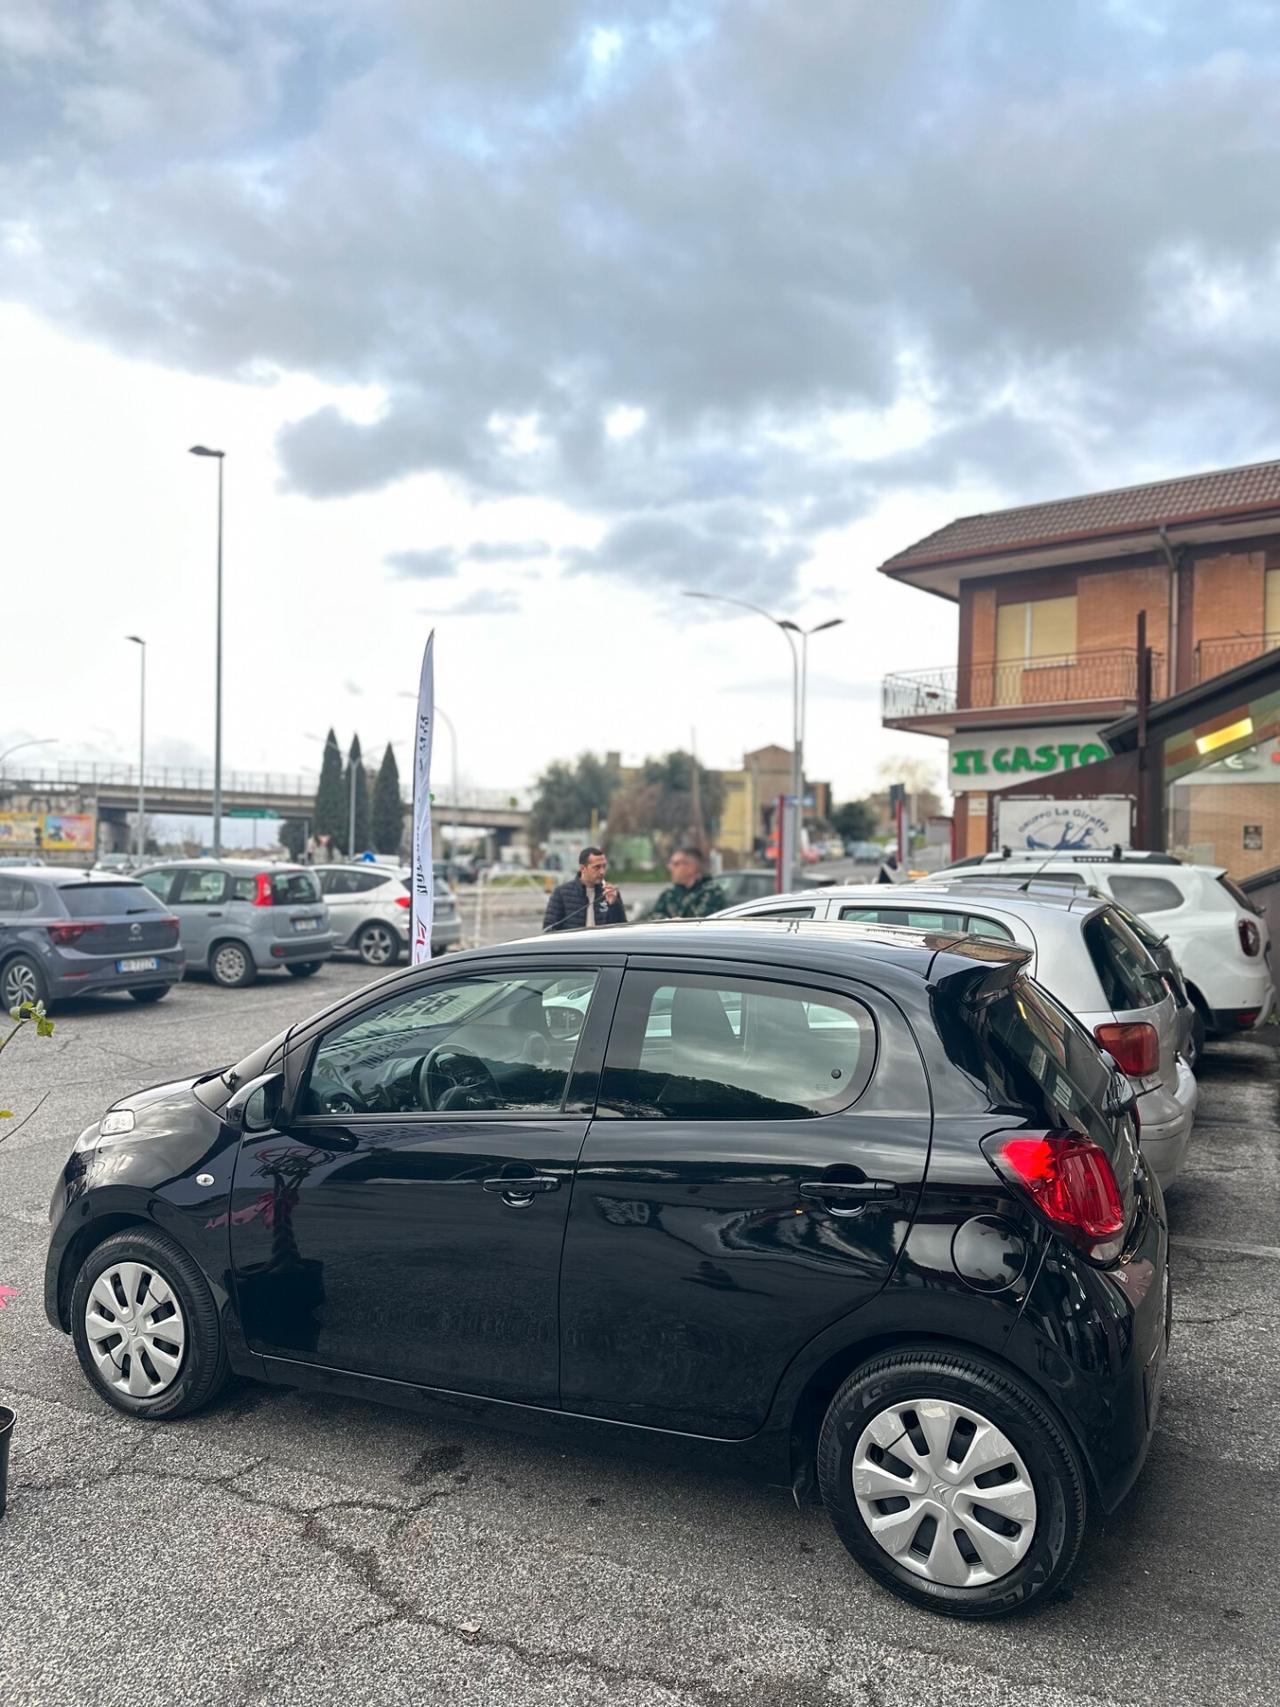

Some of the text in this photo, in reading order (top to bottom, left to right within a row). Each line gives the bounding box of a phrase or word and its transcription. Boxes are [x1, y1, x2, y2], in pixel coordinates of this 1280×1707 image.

[952, 749, 988, 776] IL
[1055, 807, 1070, 817] La
[1072, 808, 1110, 834] Giraffa
